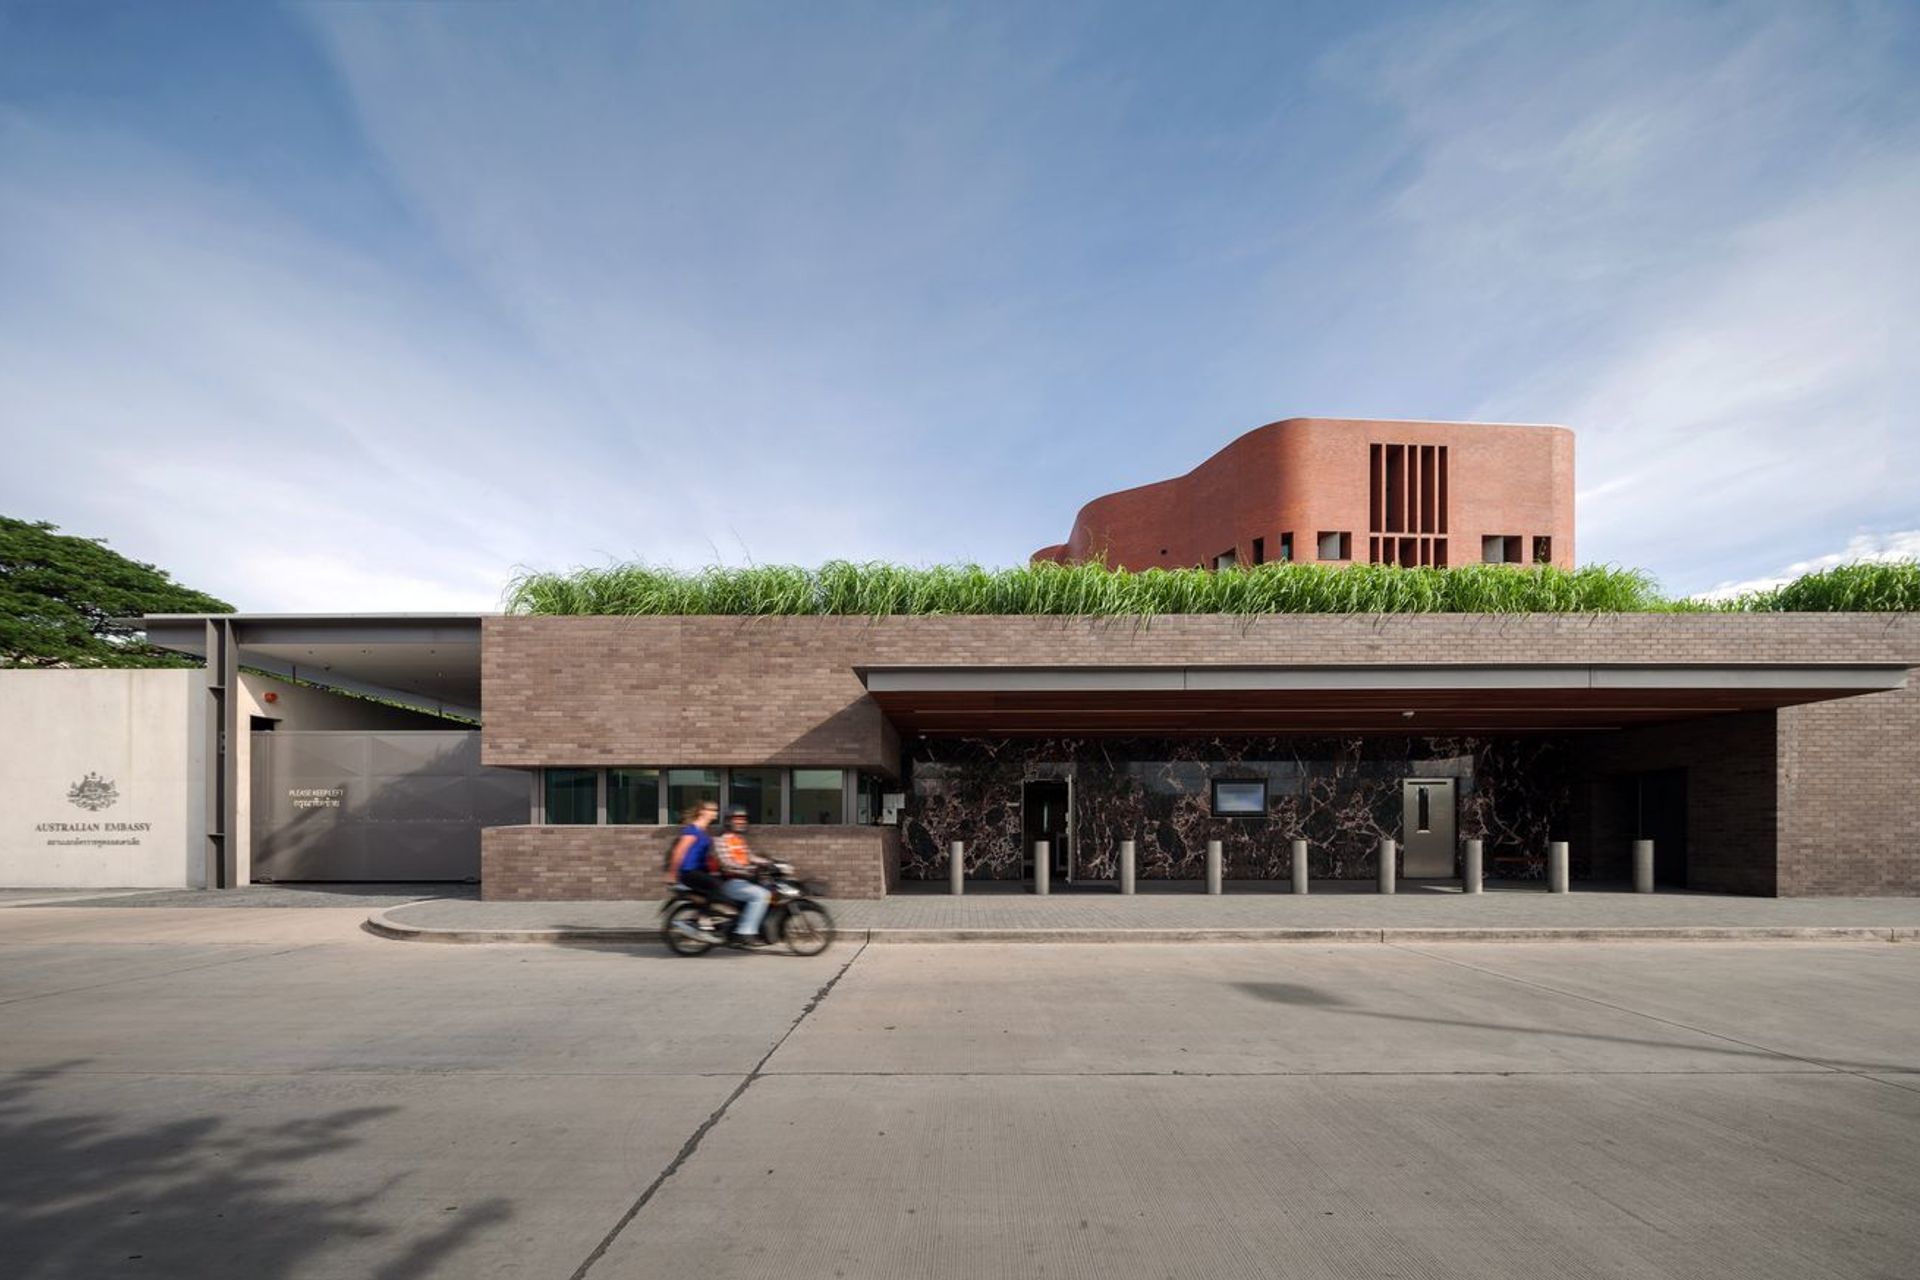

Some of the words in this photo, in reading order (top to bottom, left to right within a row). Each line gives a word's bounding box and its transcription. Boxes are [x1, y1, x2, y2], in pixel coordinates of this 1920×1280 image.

[289, 789, 311, 797] PLEASE
[35, 823, 100, 832] AUSTRALIAN
[105, 823, 152, 832] EMBASSY
